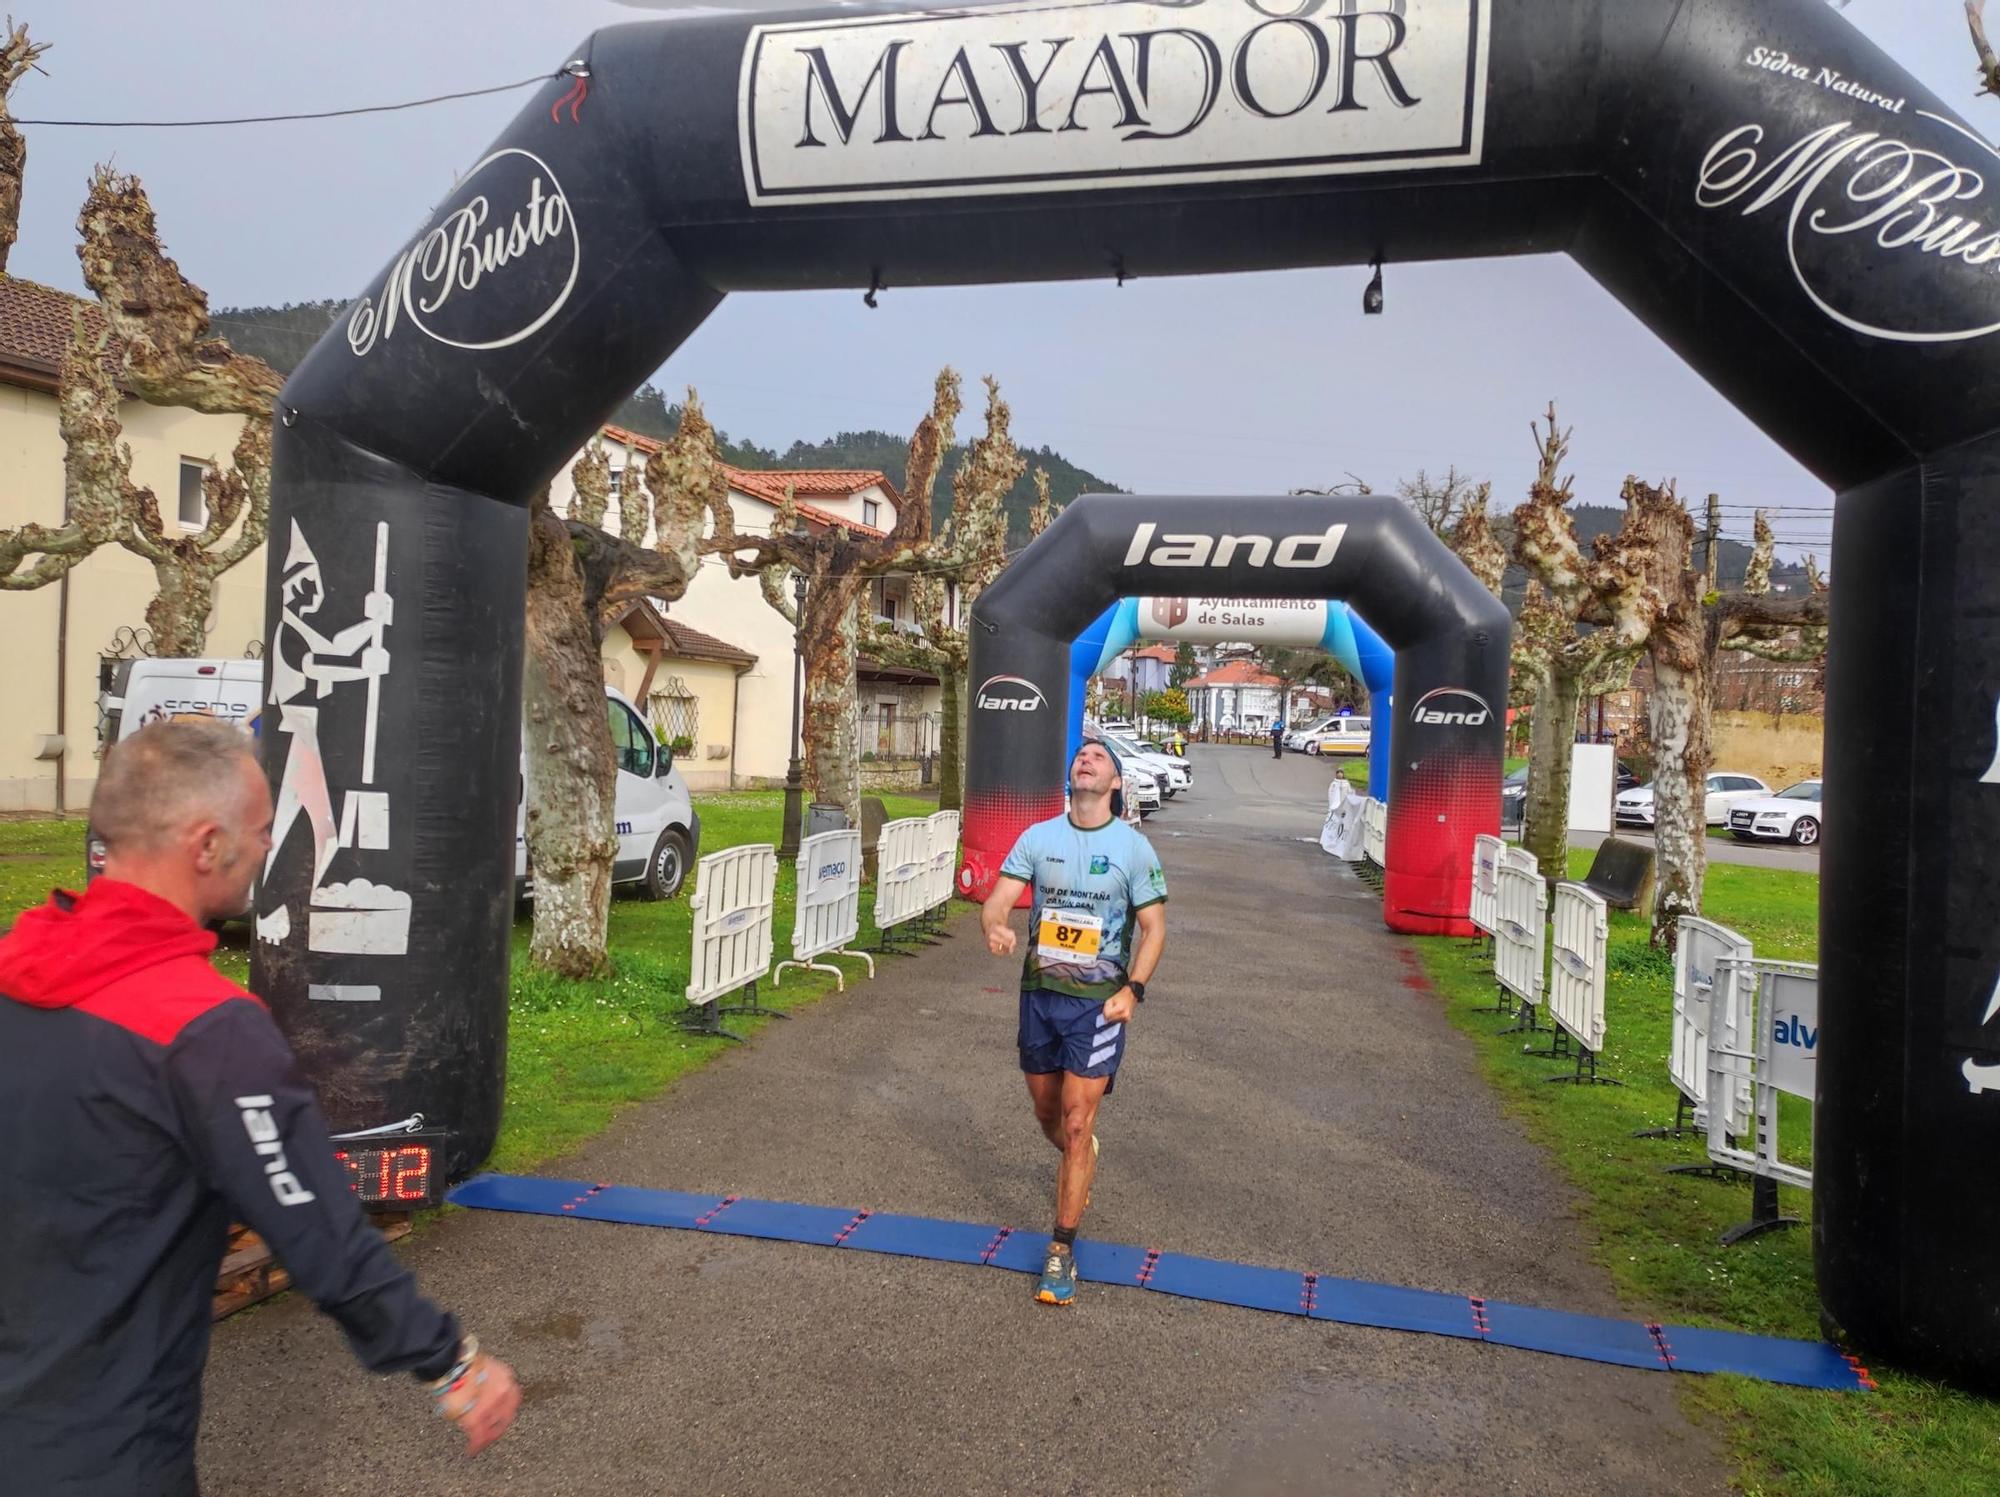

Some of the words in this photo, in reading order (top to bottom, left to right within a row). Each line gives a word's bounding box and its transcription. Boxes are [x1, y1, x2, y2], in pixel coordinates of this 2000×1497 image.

[794, 11, 1422, 148] MAYADOR
[1746, 46, 1810, 80] Sidra
[1812, 67, 1906, 114] Natural
[418, 176, 568, 313] Busto
[1123, 522, 1348, 568] land
[1198, 611, 1218, 625] de
[1221, 614, 1265, 627] Salas
[164, 699, 249, 713] crono
[977, 693, 1041, 711] land
[1414, 706, 1488, 725] land
[1056, 887, 1068, 897] DE
[1055, 925, 1083, 944] 87
[234, 1094, 316, 1206] land
